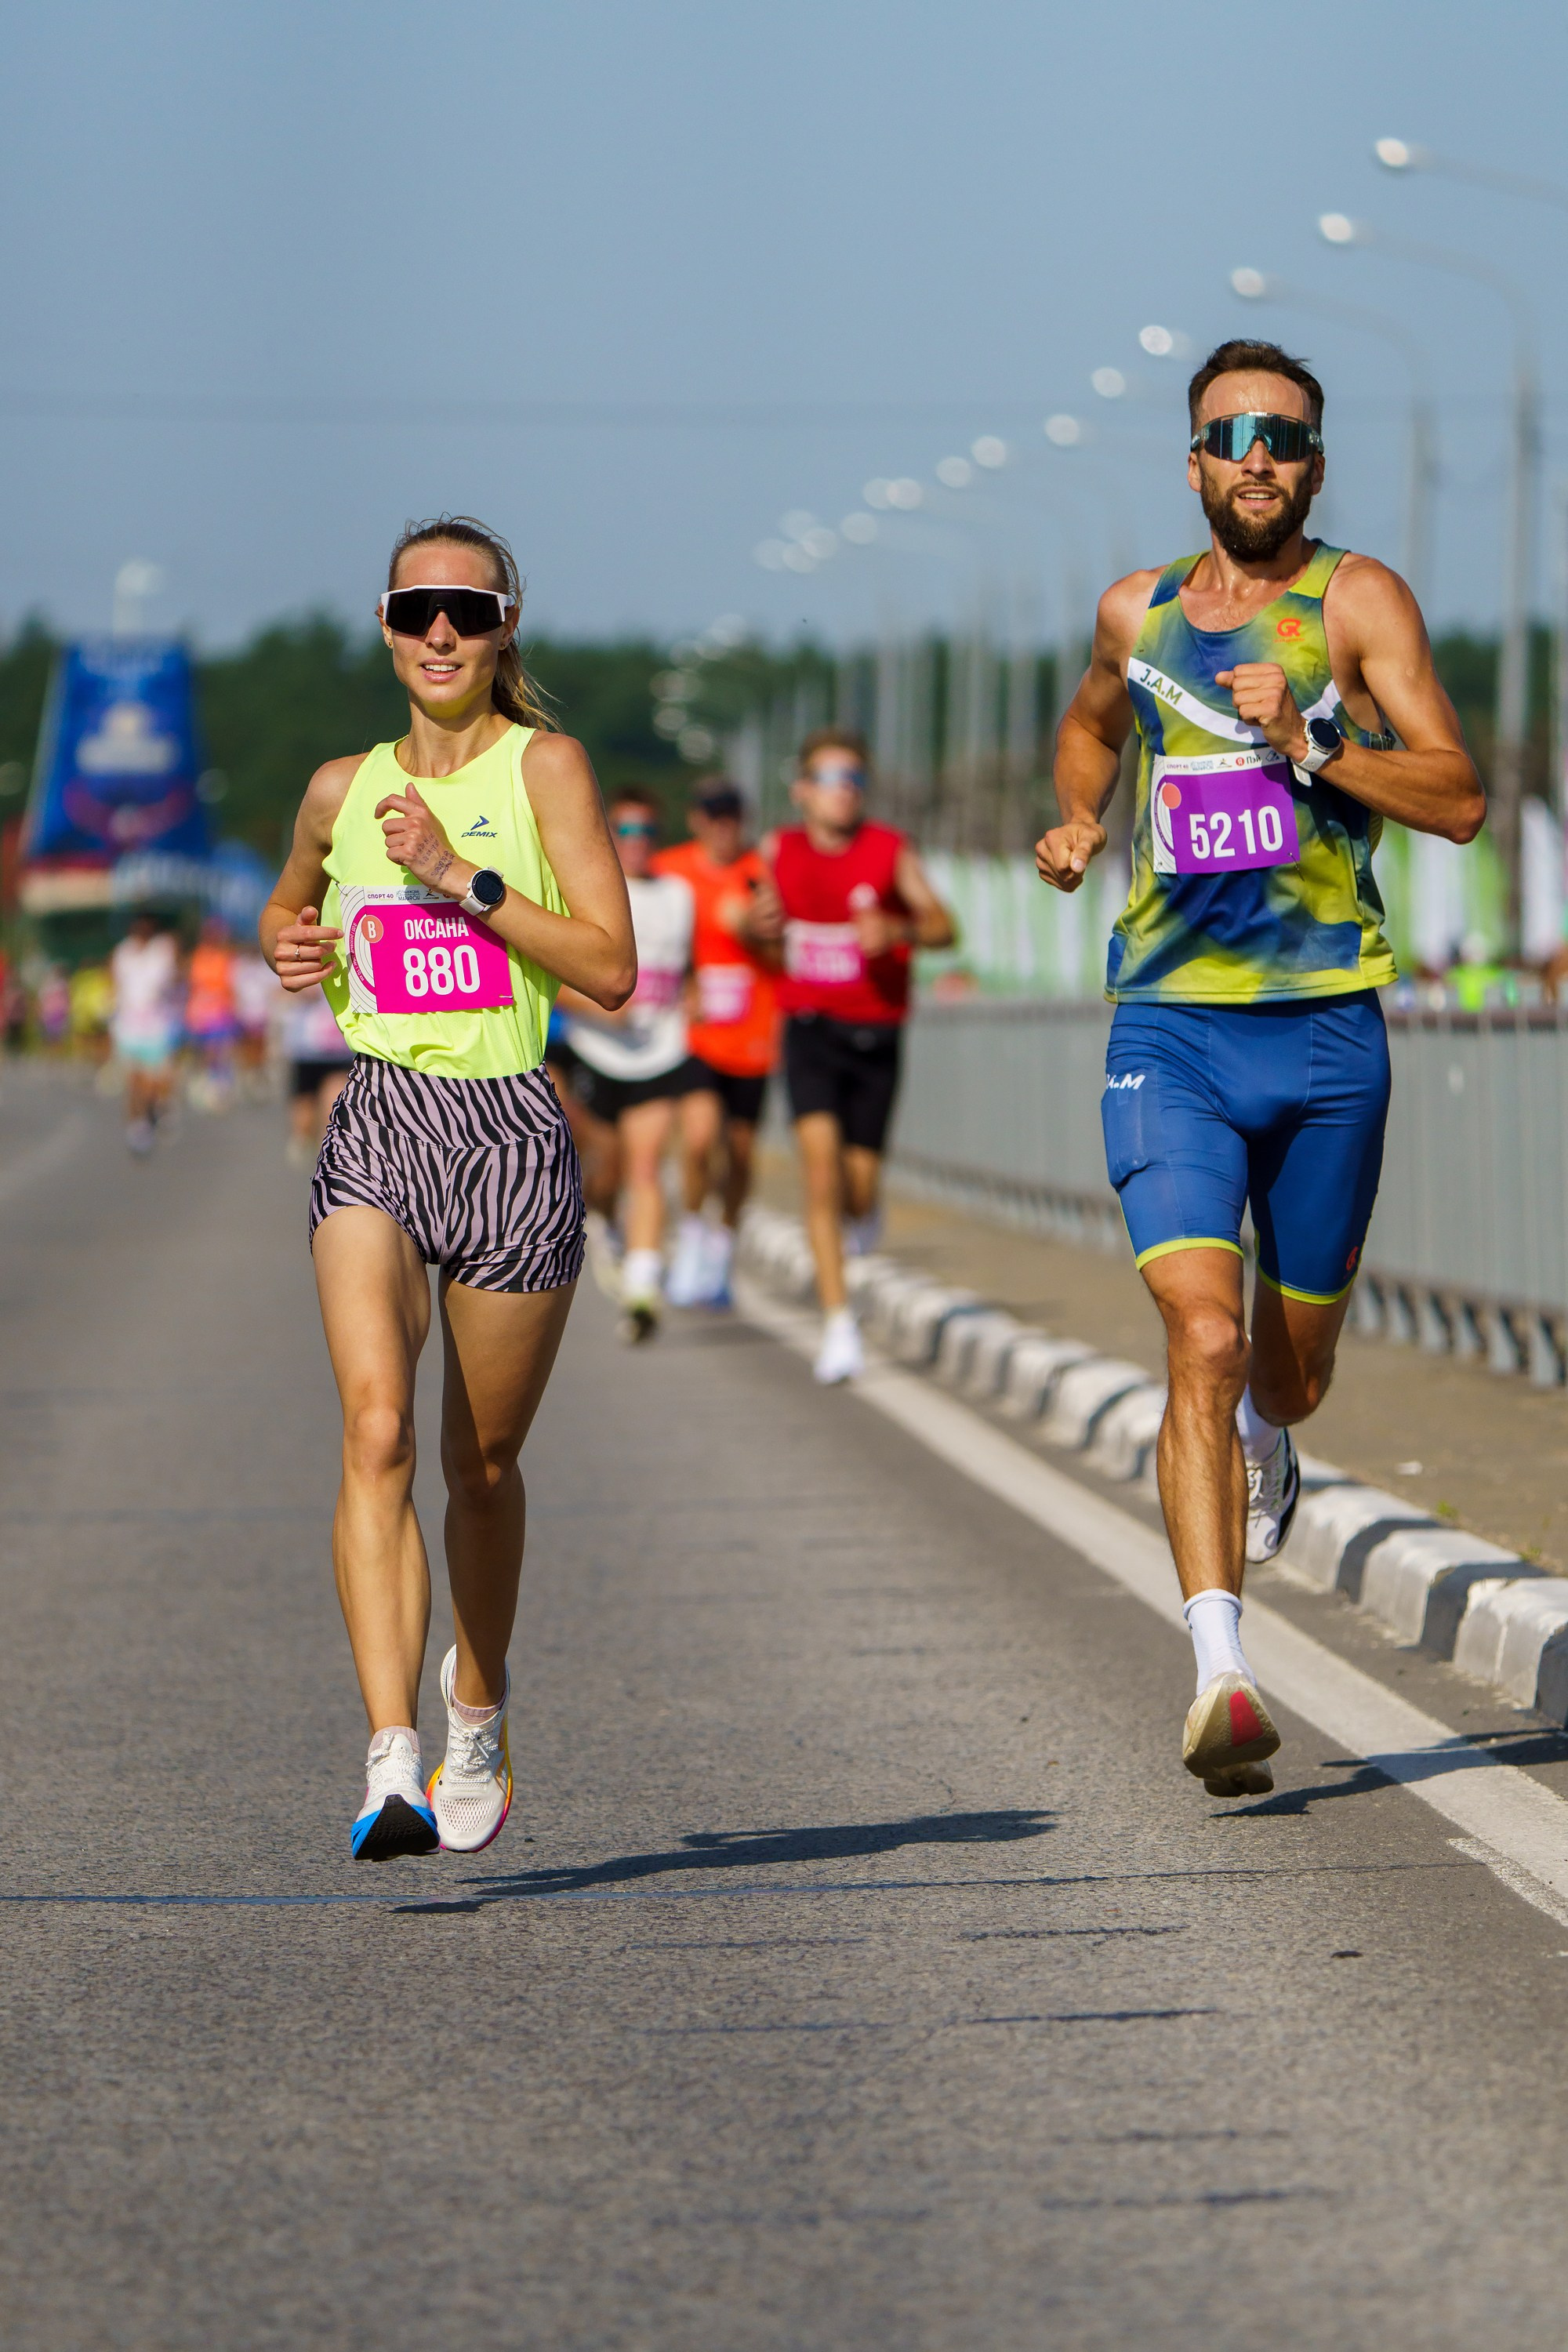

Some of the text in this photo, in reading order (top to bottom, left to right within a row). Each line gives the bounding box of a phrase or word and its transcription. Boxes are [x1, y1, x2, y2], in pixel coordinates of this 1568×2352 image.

[1140, 668, 1182, 706] J.A.M
[1247, 754, 1261, 764] Пэй
[1189, 806, 1283, 859] 5210
[405, 916, 469, 940] ОКСАНА
[403, 945, 481, 997] 880
